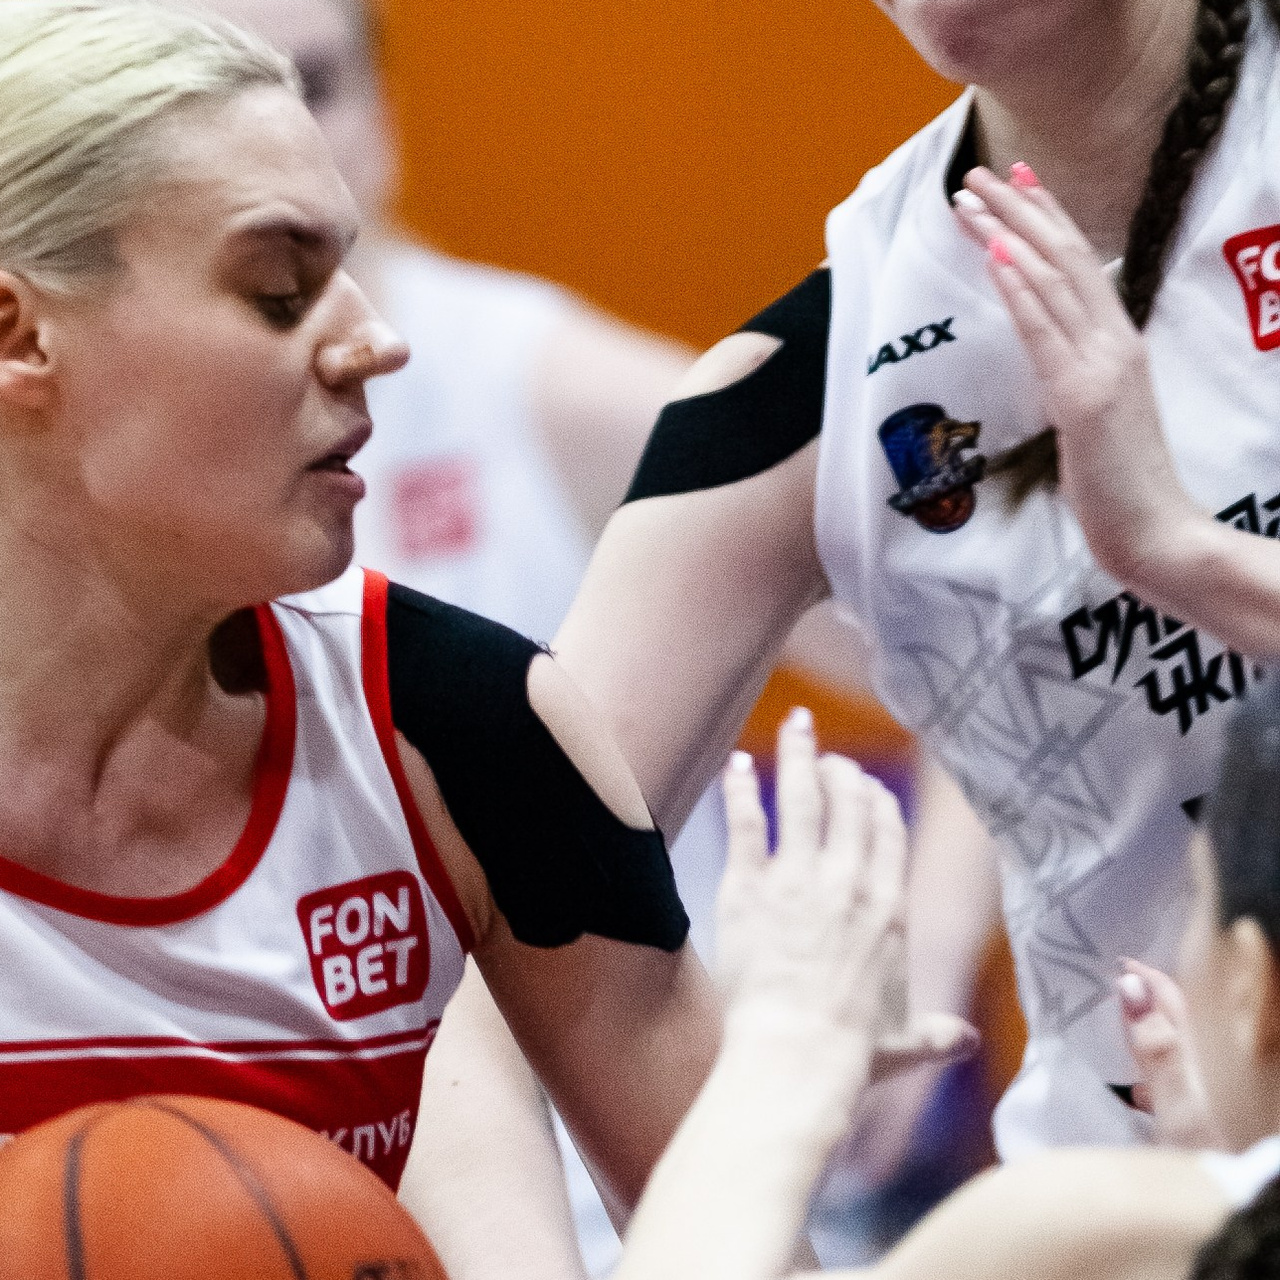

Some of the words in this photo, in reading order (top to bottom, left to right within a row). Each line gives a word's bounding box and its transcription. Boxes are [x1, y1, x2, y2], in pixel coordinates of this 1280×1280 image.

[866, 317, 957, 376] AXX
[310, 886, 410, 956] FON
[322, 935, 418, 1008] BET
